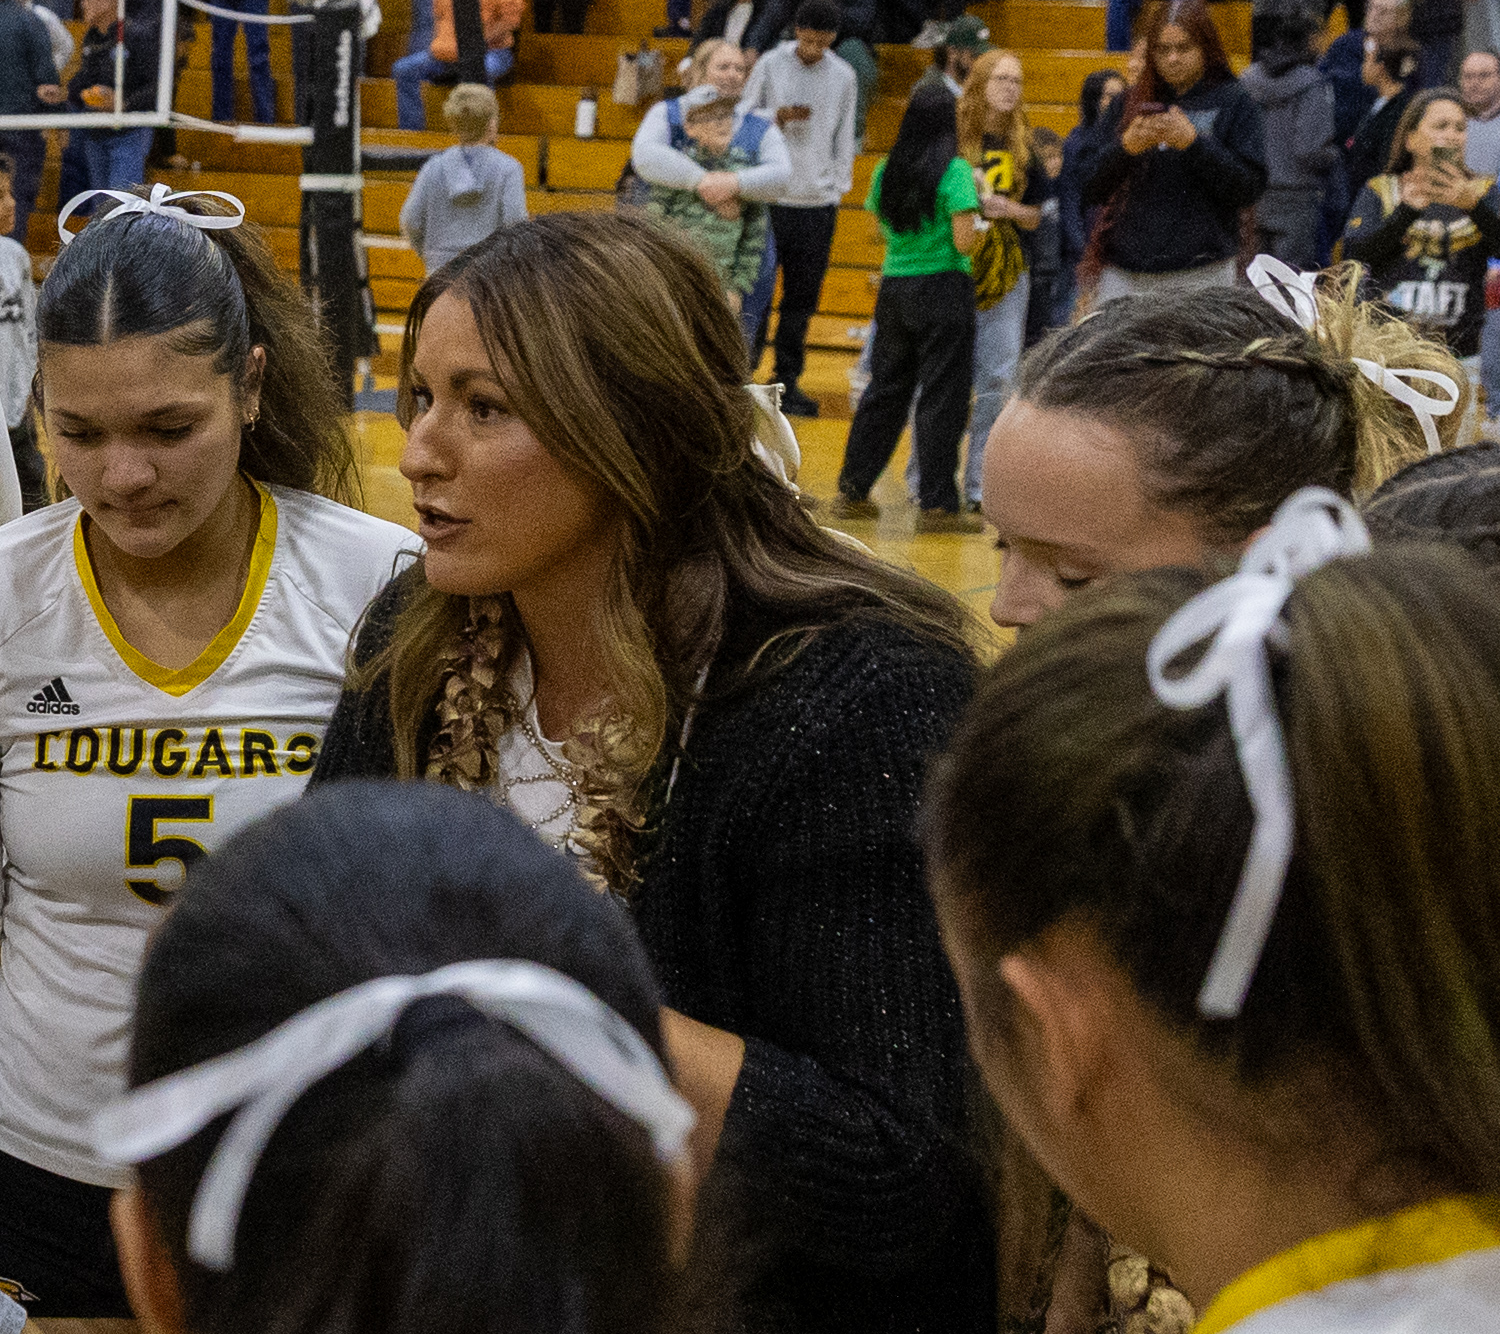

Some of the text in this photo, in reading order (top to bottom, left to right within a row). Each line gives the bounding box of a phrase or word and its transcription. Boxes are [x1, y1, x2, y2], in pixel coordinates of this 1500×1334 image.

[26, 700, 80, 715] adidas
[34, 727, 319, 779] COUGARS
[125, 794, 214, 907] 5
